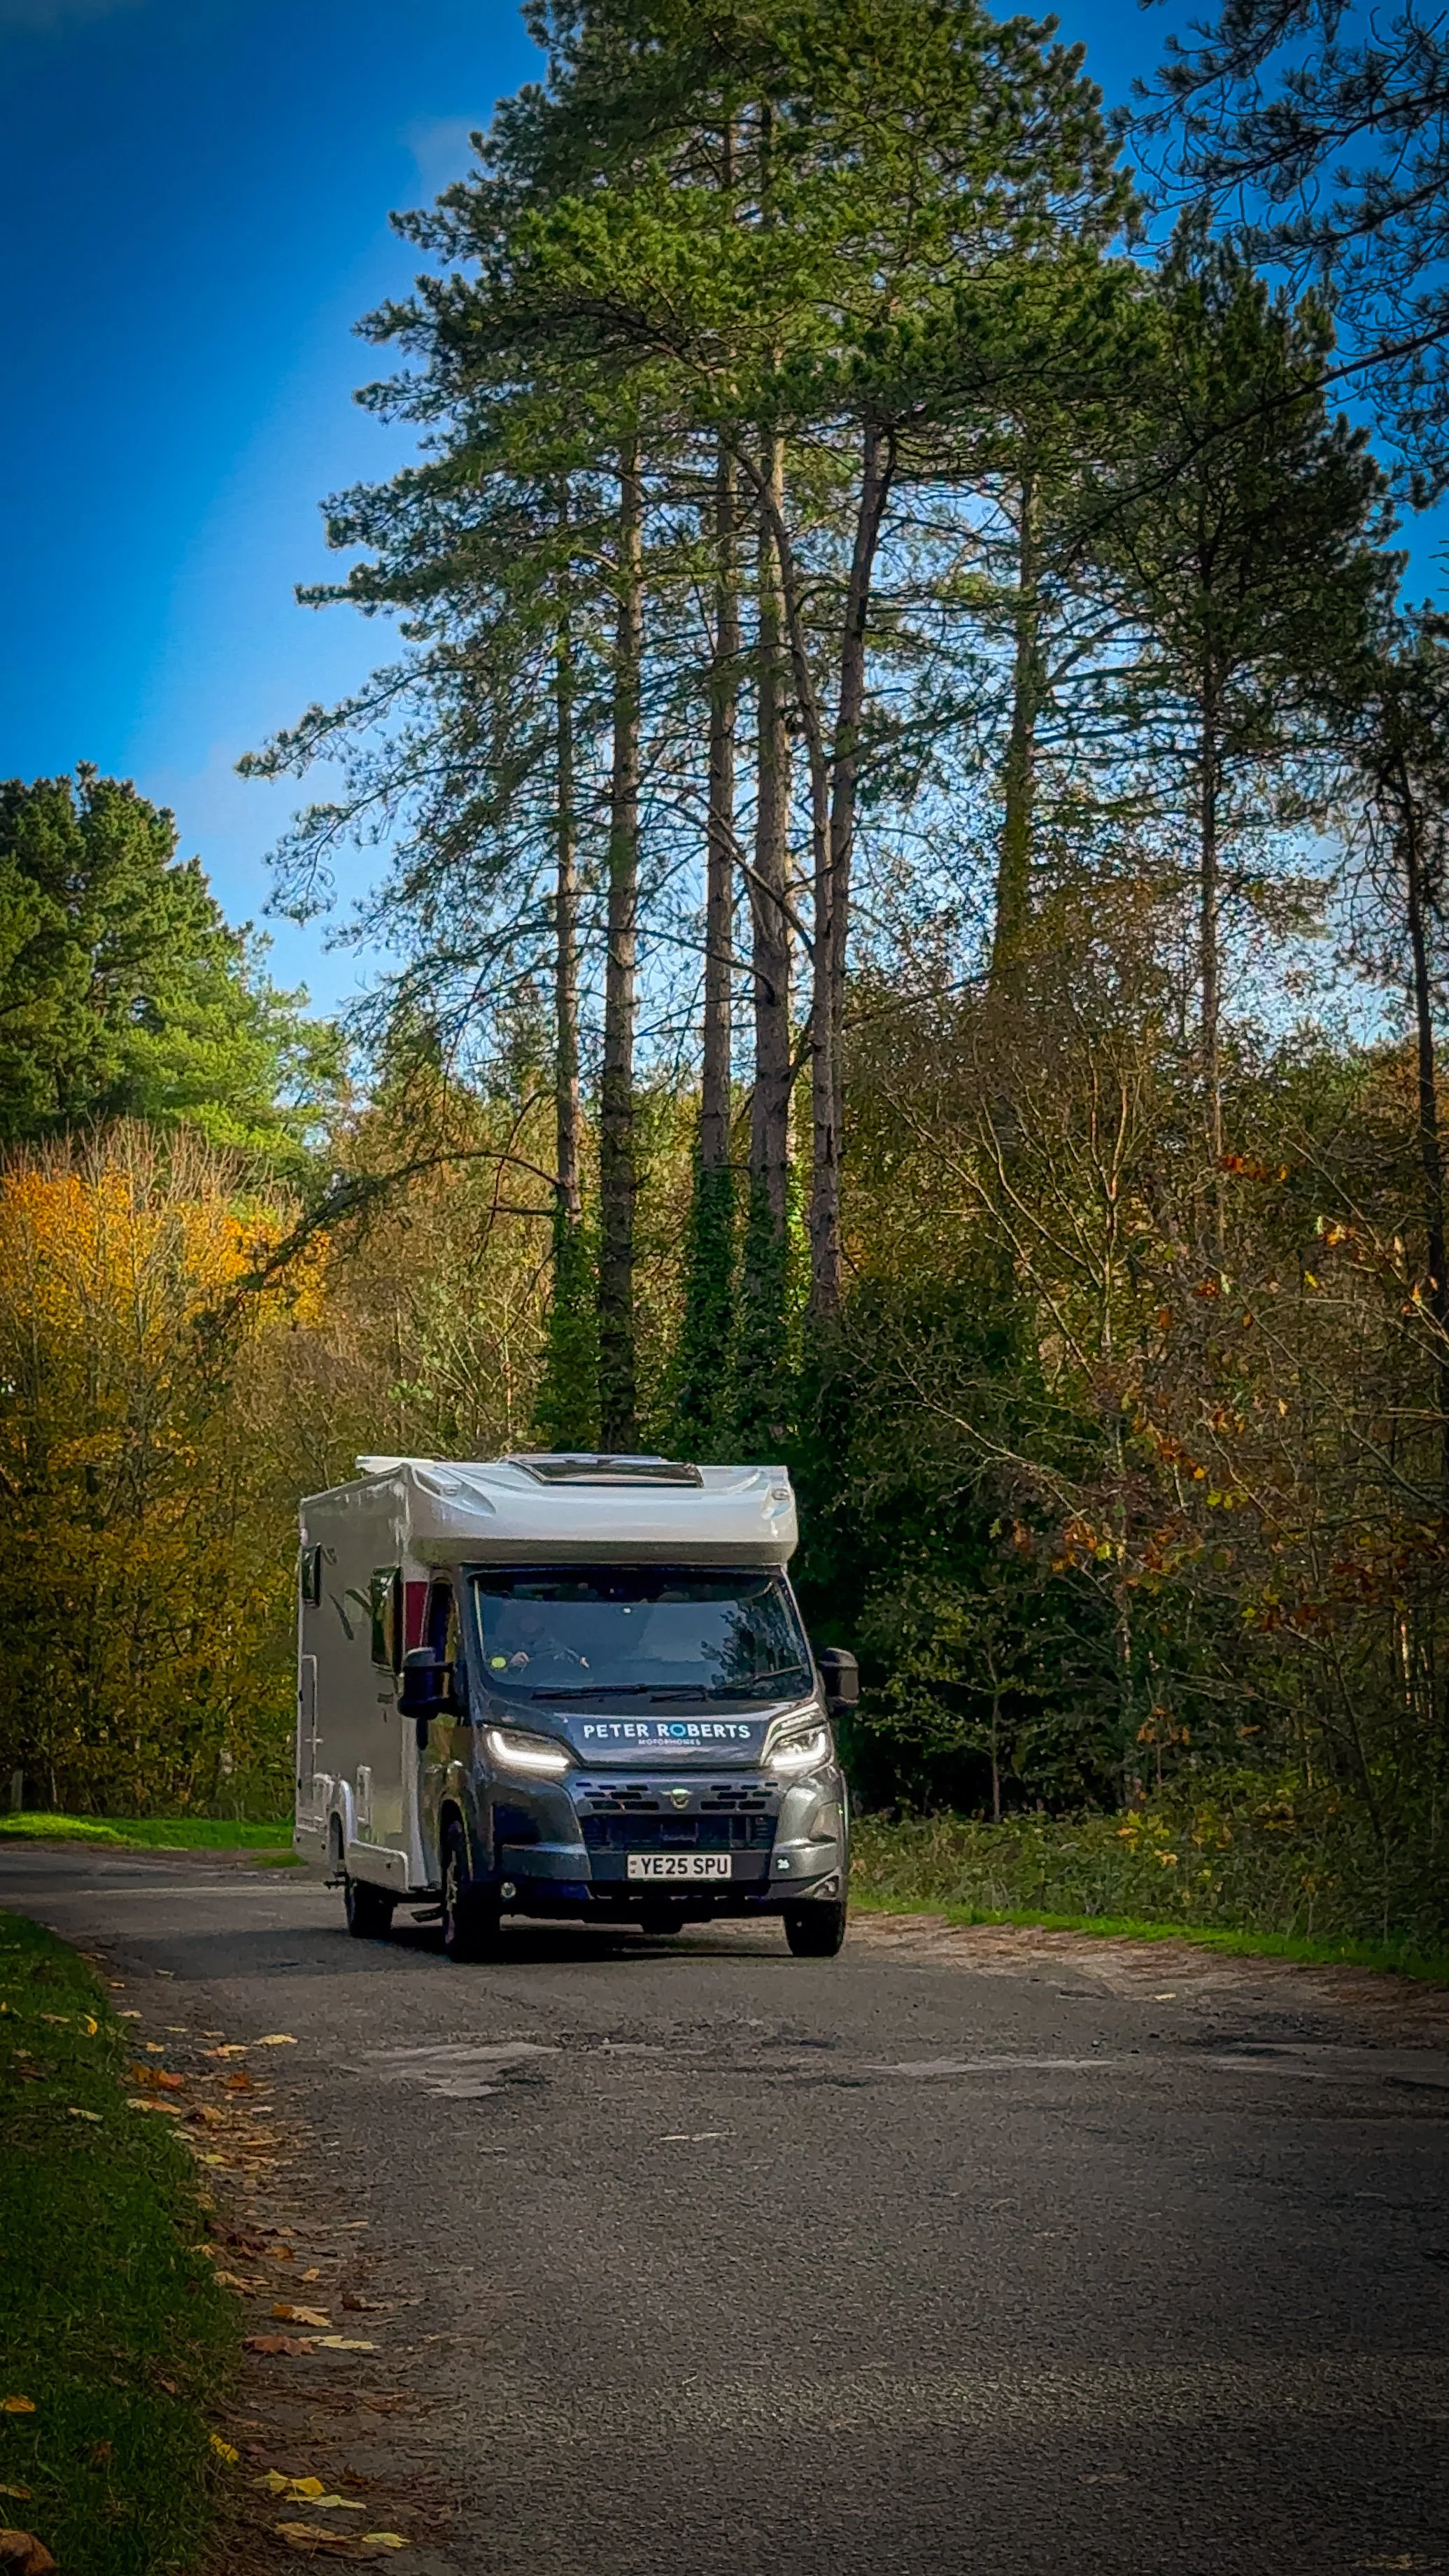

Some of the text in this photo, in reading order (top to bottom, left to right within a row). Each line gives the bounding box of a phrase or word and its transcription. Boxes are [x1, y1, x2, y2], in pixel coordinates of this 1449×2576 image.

[584, 1724, 751, 1739] PETER ROBERTS
[641, 1857, 728, 1875] YE25 SPU
